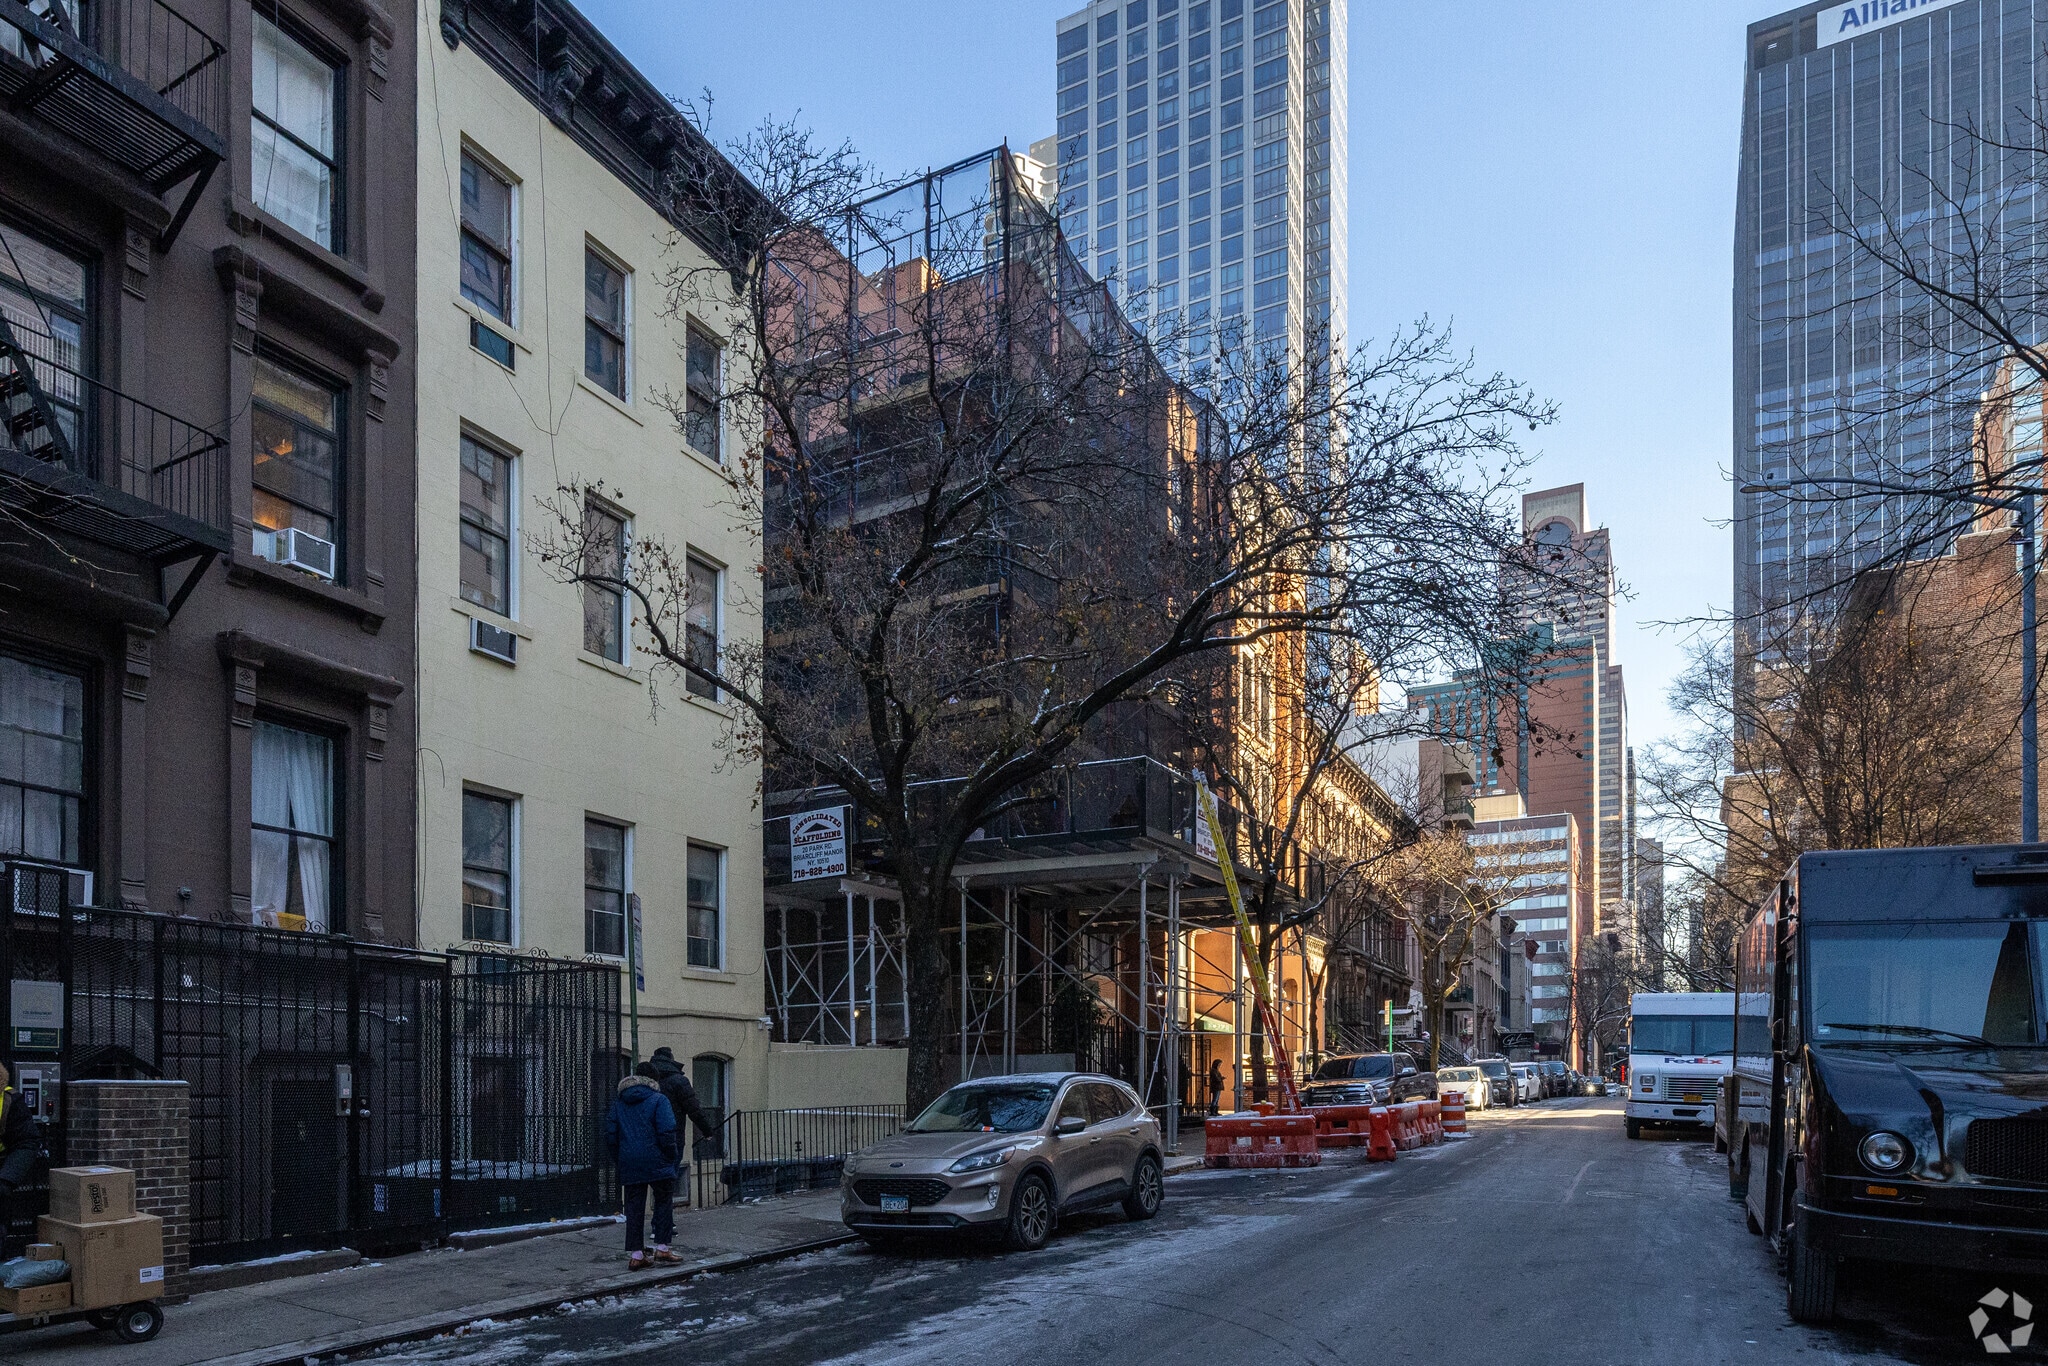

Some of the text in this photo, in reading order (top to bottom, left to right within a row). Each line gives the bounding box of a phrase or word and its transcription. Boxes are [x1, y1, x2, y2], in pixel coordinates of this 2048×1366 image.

[1839, 0, 1938, 33] Allia
[792, 813, 842, 834] CONSOLIDATED
[794, 830, 841, 844] SCAFFOLDING
[793, 848, 843, 861] BRIARCLIFF MANOR
[809, 844, 823, 852] PARK
[817, 857, 829, 865] 10510
[793, 863, 844, 879] 718-828-4900
[1664, 1057, 1723, 1065] FedEx
[89, 1183, 102, 1213] Presto!
